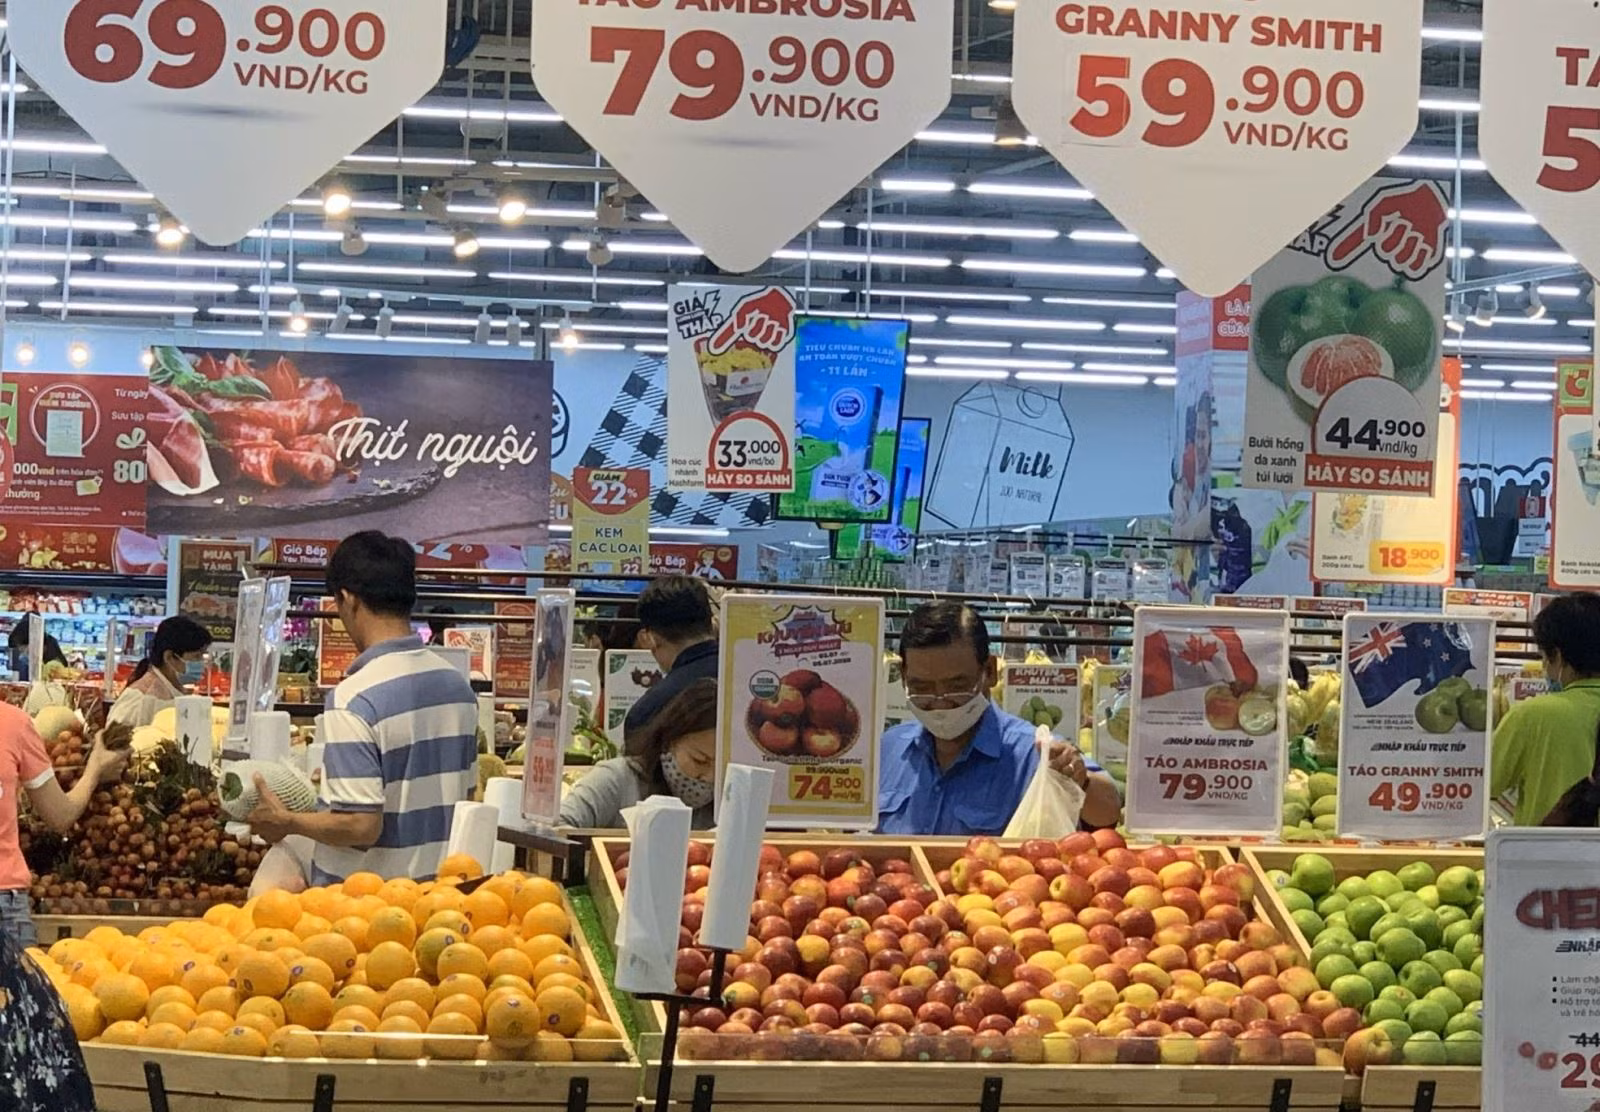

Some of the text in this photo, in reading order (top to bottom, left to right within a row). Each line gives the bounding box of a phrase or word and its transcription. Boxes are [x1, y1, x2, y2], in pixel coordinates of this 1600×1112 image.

[1055, 3, 1383, 53] GRANNY SMITH
[233, 63, 368, 94] VND/KG
[750, 92, 879, 122] VND/KG
[1223, 121, 1348, 151] VND/KG
[328, 416, 538, 478] Thịt nguội
[1378, 441, 1418, 457] vnd/kg
[999, 446, 1057, 479] Milk
[1254, 454, 1297, 466] da xanh
[735, 474, 754, 486] SO
[756, 471, 791, 486] SÁNH
[1351, 467, 1375, 484] SO
[1379, 466, 1429, 487] SÁNH
[595, 527, 623, 539] KEM
[1145, 753, 1269, 771] TÁO AMBROSIA
[1348, 763, 1484, 778] TÁO GRANNY SMITH
[1207, 791, 1249, 801] VND/KG
[1421, 801, 1464, 811] VND/KG
